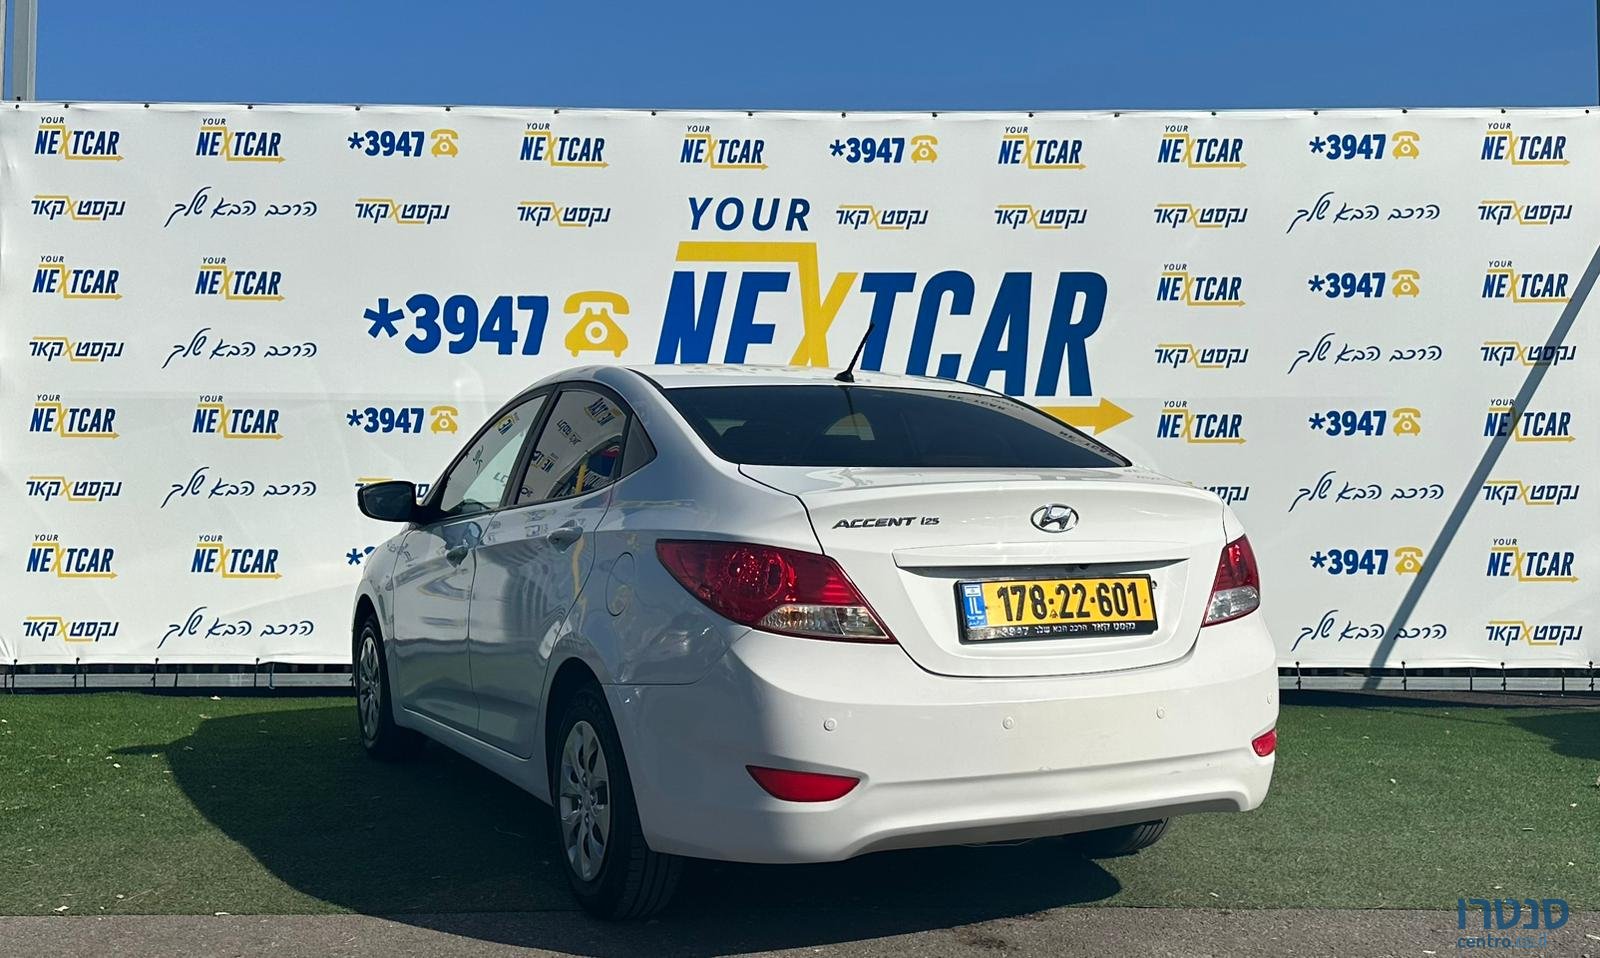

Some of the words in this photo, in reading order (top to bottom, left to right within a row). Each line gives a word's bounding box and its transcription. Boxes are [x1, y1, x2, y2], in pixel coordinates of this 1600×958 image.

[40, 116, 65, 124] YOUR
[202, 117, 226, 126] YOUR
[526, 122, 550, 131] YOUR
[687, 125, 711, 133] YOUR
[1005, 126, 1029, 134] YOUR
[1165, 124, 1189, 133] YOUR
[1488, 122, 1512, 130] YOUR
[35, 130, 120, 156] NEXTCAR
[196, 131, 282, 157] NEXTCAR
[520, 136, 605, 162] NEXTCAR
[680, 138, 765, 164] NEXTCAR
[998, 139, 1083, 165] NEXTCAR
[1158, 138, 1244, 164] NEXTCAR
[1481, 135, 1567, 161] NEXTCAR
[210, 197, 258, 219] הבא
[689, 196, 811, 231] YOUR
[1333, 202, 1381, 224] הבא
[40, 255, 65, 263] YOUR
[202, 256, 227, 265] YOUR
[1163, 263, 1188, 271] YOUR
[1488, 260, 1513, 268] YOUR
[33, 269, 120, 294] NEXTCAR
[195, 270, 282, 296] NEXTCAR
[1157, 276, 1243, 302] NEXTCAR
[1482, 273, 1569, 299] NEXTCAR
[655, 270, 1108, 397] NEXTCAR
[208, 338, 256, 360] הבא
[1334, 343, 1382, 365] הבא
[37, 394, 61, 402] YOUR
[199, 394, 224, 403] YOUR
[1163, 400, 1188, 408] YOUR
[1490, 399, 1515, 407] YOUR
[30, 407, 116, 433] NEXTCAR
[193, 408, 280, 434] NEXTCAR
[1157, 413, 1243, 439] NEXTCAR
[1484, 412, 1571, 437] NEXTCAR
[207, 477, 255, 499] הבא
[1334, 481, 1382, 503] הבא
[832, 517, 917, 529] ACCENT
[34, 534, 59, 542] YOUR
[198, 534, 223, 542] YOUR
[1493, 538, 1518, 546] YOUR
[27, 547, 115, 573] NEXTCAR
[191, 548, 279, 574] NEXTCAR
[1487, 551, 1575, 577] NEXTCAR
[969, 597, 983, 615] IL
[204, 617, 252, 639] הבא
[1337, 620, 1385, 642] הבא
